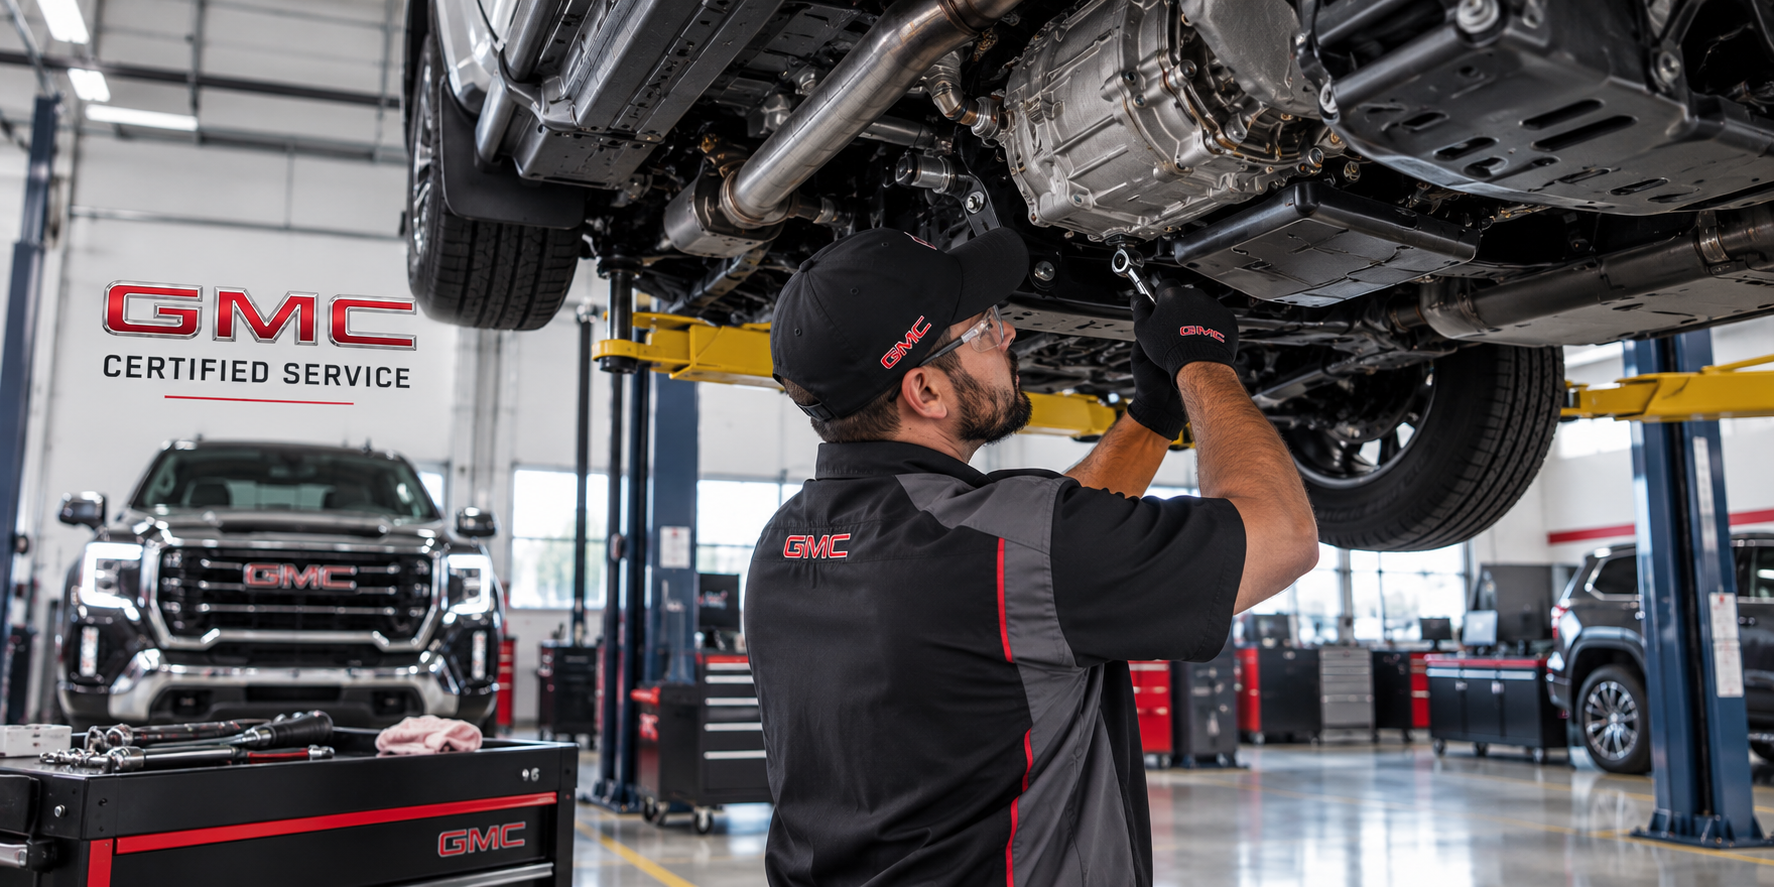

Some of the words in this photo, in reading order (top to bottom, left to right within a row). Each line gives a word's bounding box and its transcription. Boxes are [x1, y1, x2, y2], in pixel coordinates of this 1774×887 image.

[102, 279, 417, 351] GMC
[880, 315, 932, 369] GMC
[103, 354, 269, 384] CERTIFIED
[283, 362, 410, 389] SERVICE
[783, 533, 851, 559] GMC
[243, 563, 358, 590] GMC
[438, 821, 526, 857] GMC
